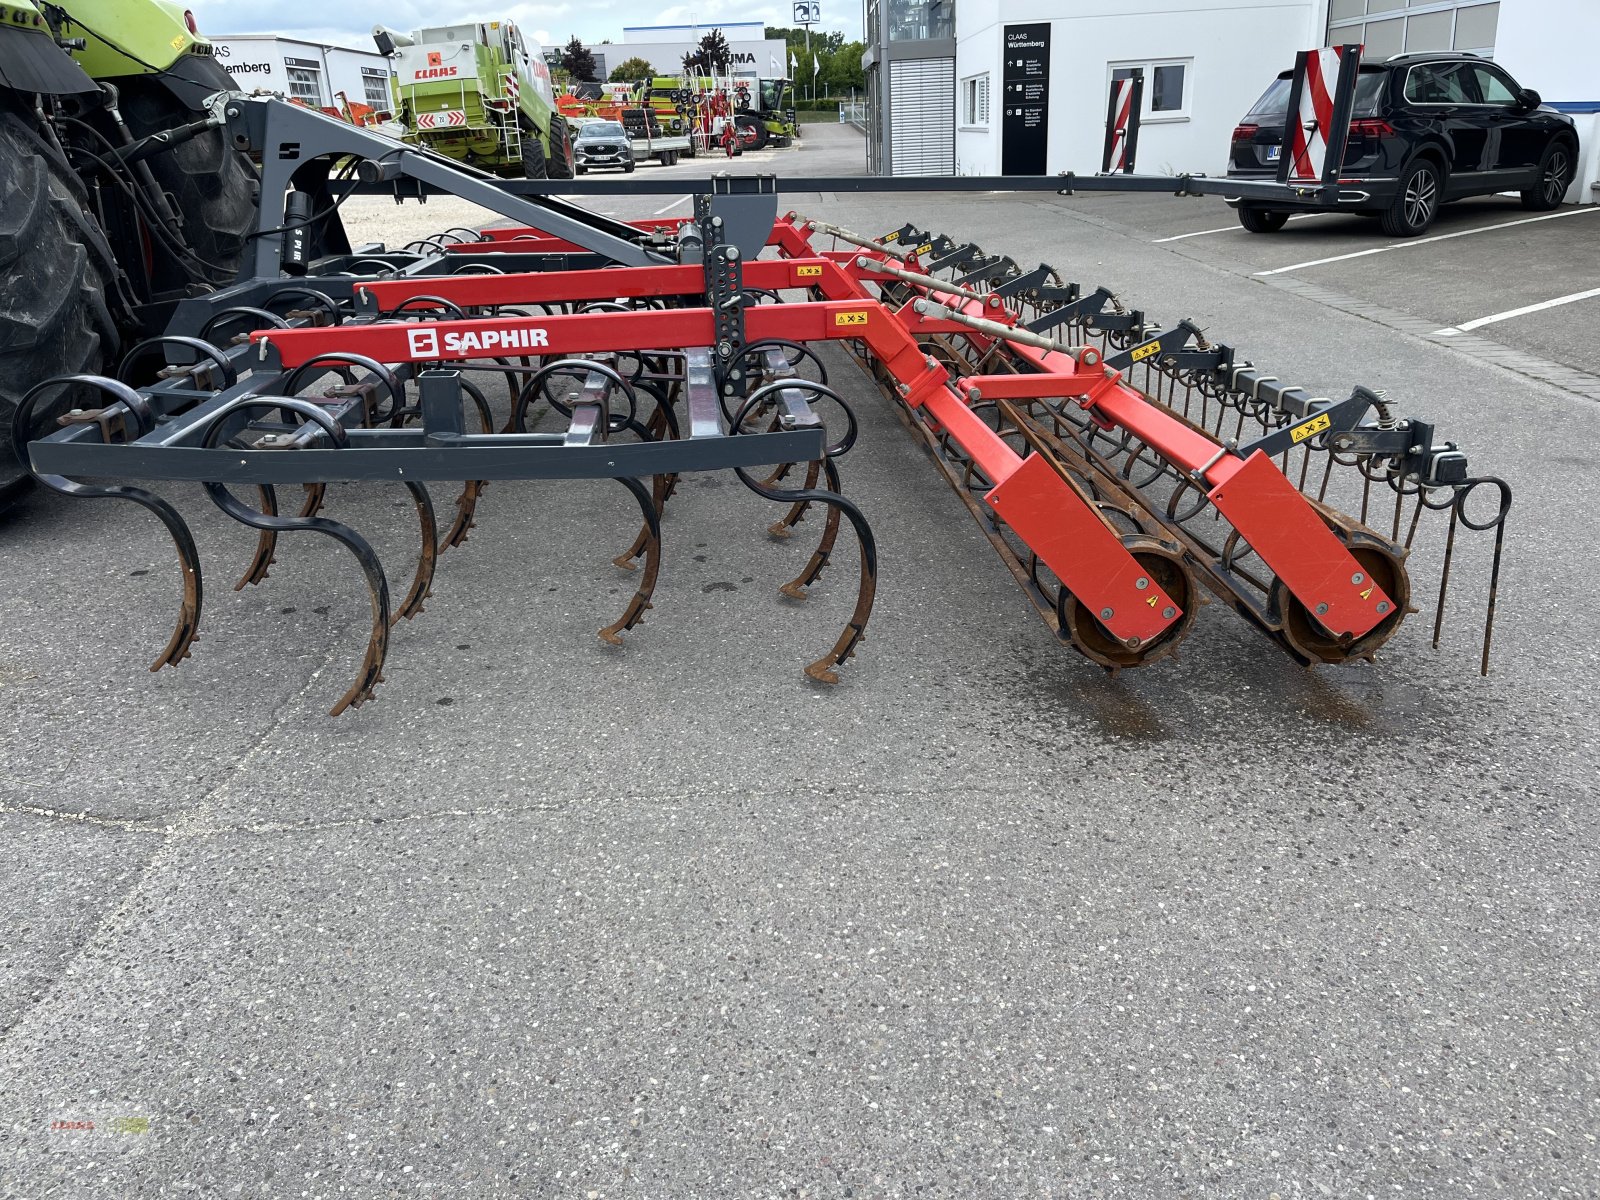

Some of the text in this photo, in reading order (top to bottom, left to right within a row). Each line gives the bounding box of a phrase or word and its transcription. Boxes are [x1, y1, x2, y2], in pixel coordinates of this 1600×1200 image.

[1008, 33, 1028, 41] CLAAS
[1007, 41, 1045, 49] Württemberg
[415, 66, 457, 80] CLAAS
[444, 328, 549, 352] SAPHIR
